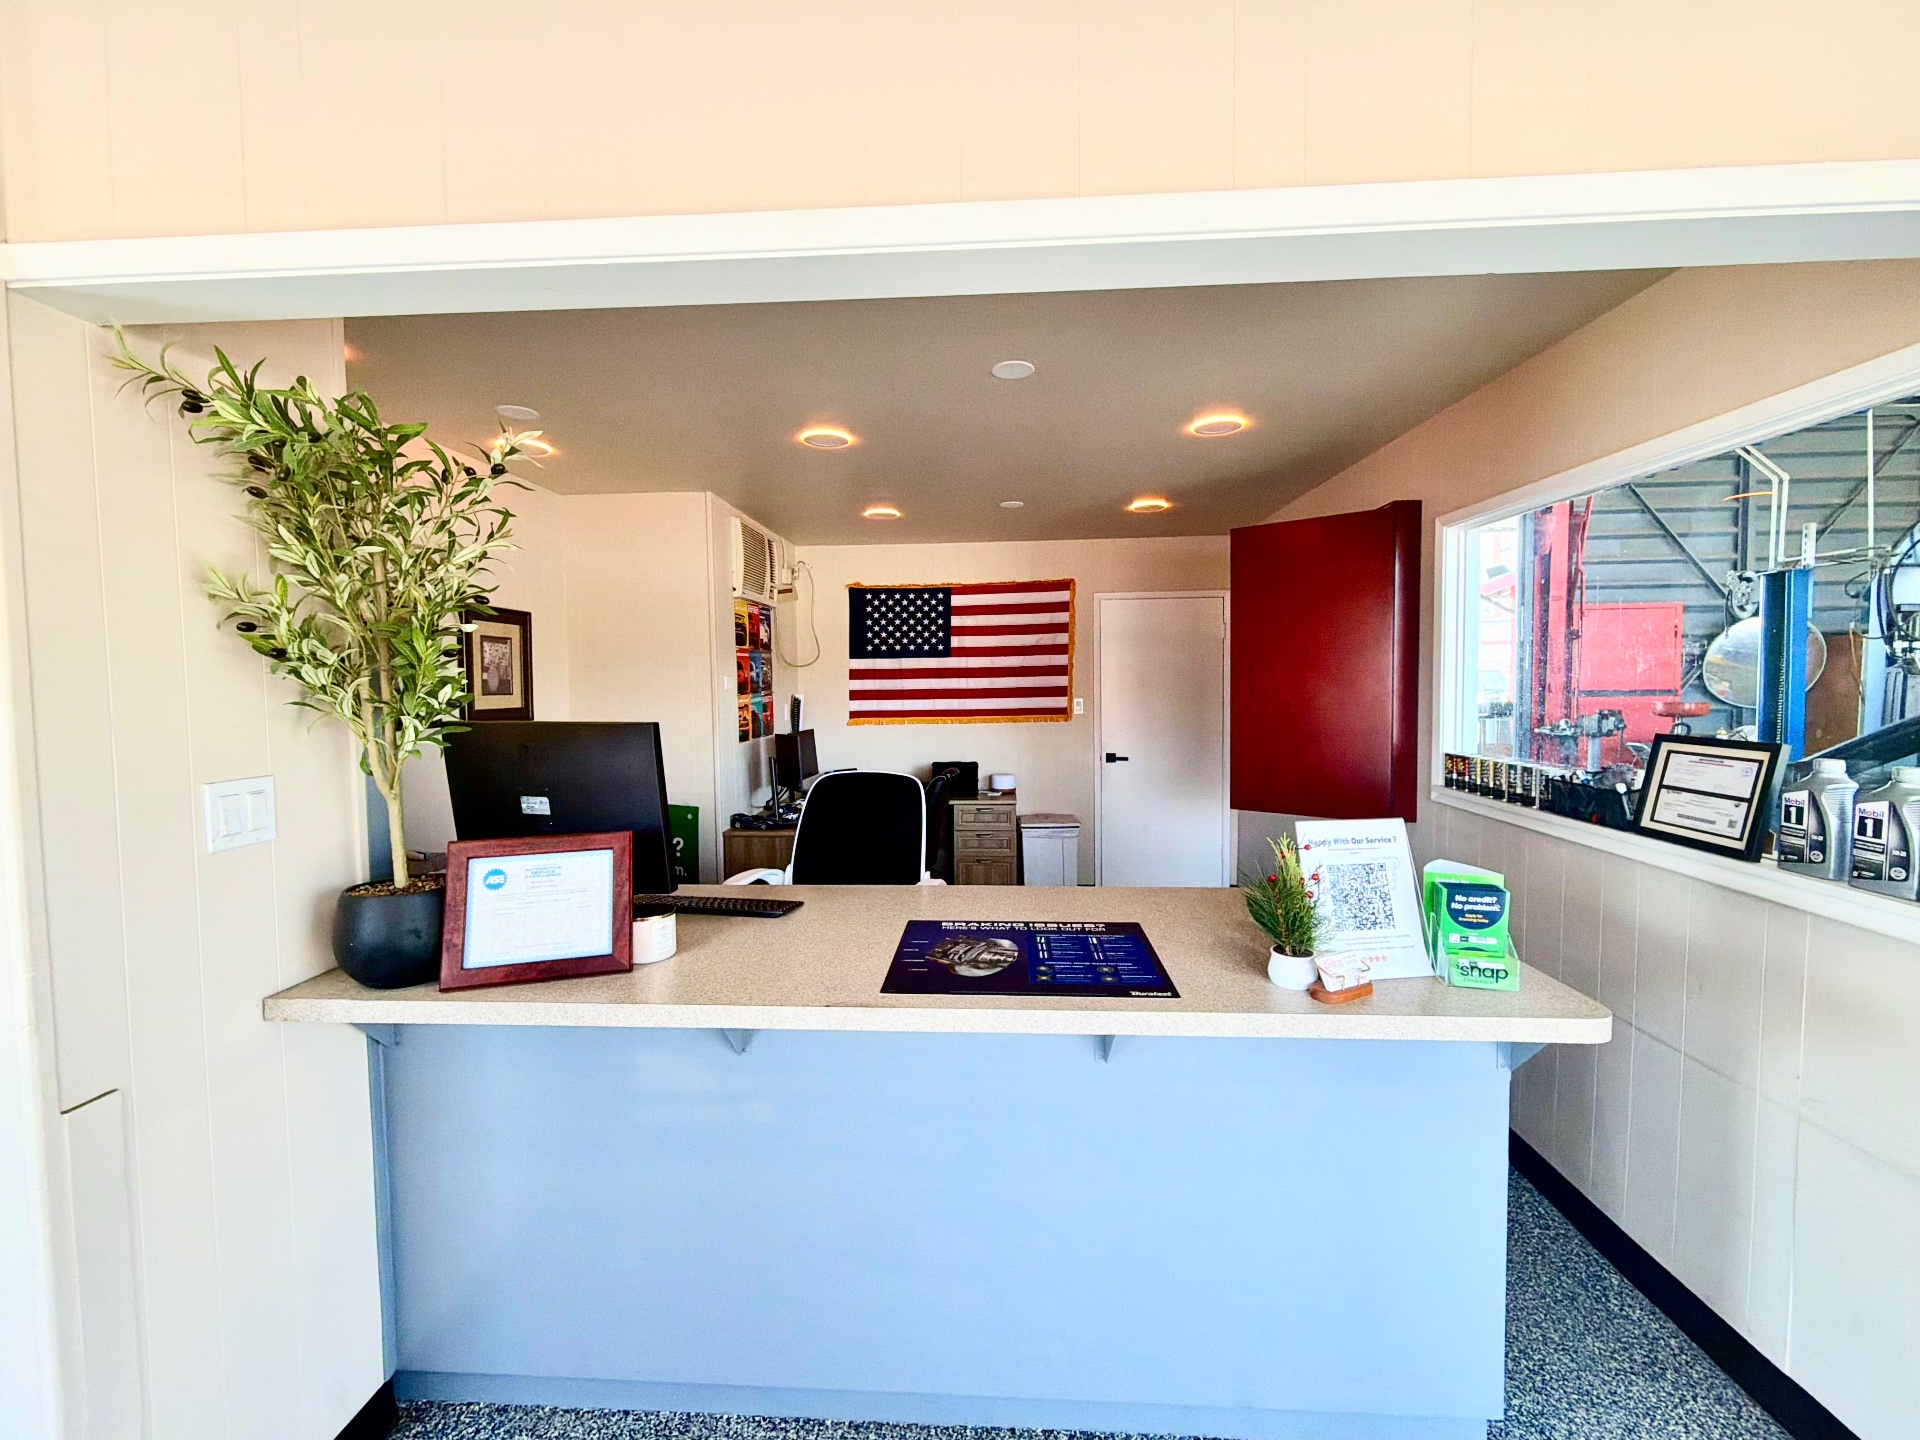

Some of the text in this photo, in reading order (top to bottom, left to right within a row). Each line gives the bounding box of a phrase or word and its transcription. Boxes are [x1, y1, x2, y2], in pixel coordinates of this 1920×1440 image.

[1784, 797, 1805, 806] Mobil
[1788, 806, 1797, 823] 1
[1859, 808, 1885, 818] Mobil
[1864, 819, 1874, 837] 1
[1351, 837, 1364, 845] Our
[1365, 836, 1391, 844] Service
[485, 875, 505, 885] ASE
[1460, 964, 1508, 983] snap
